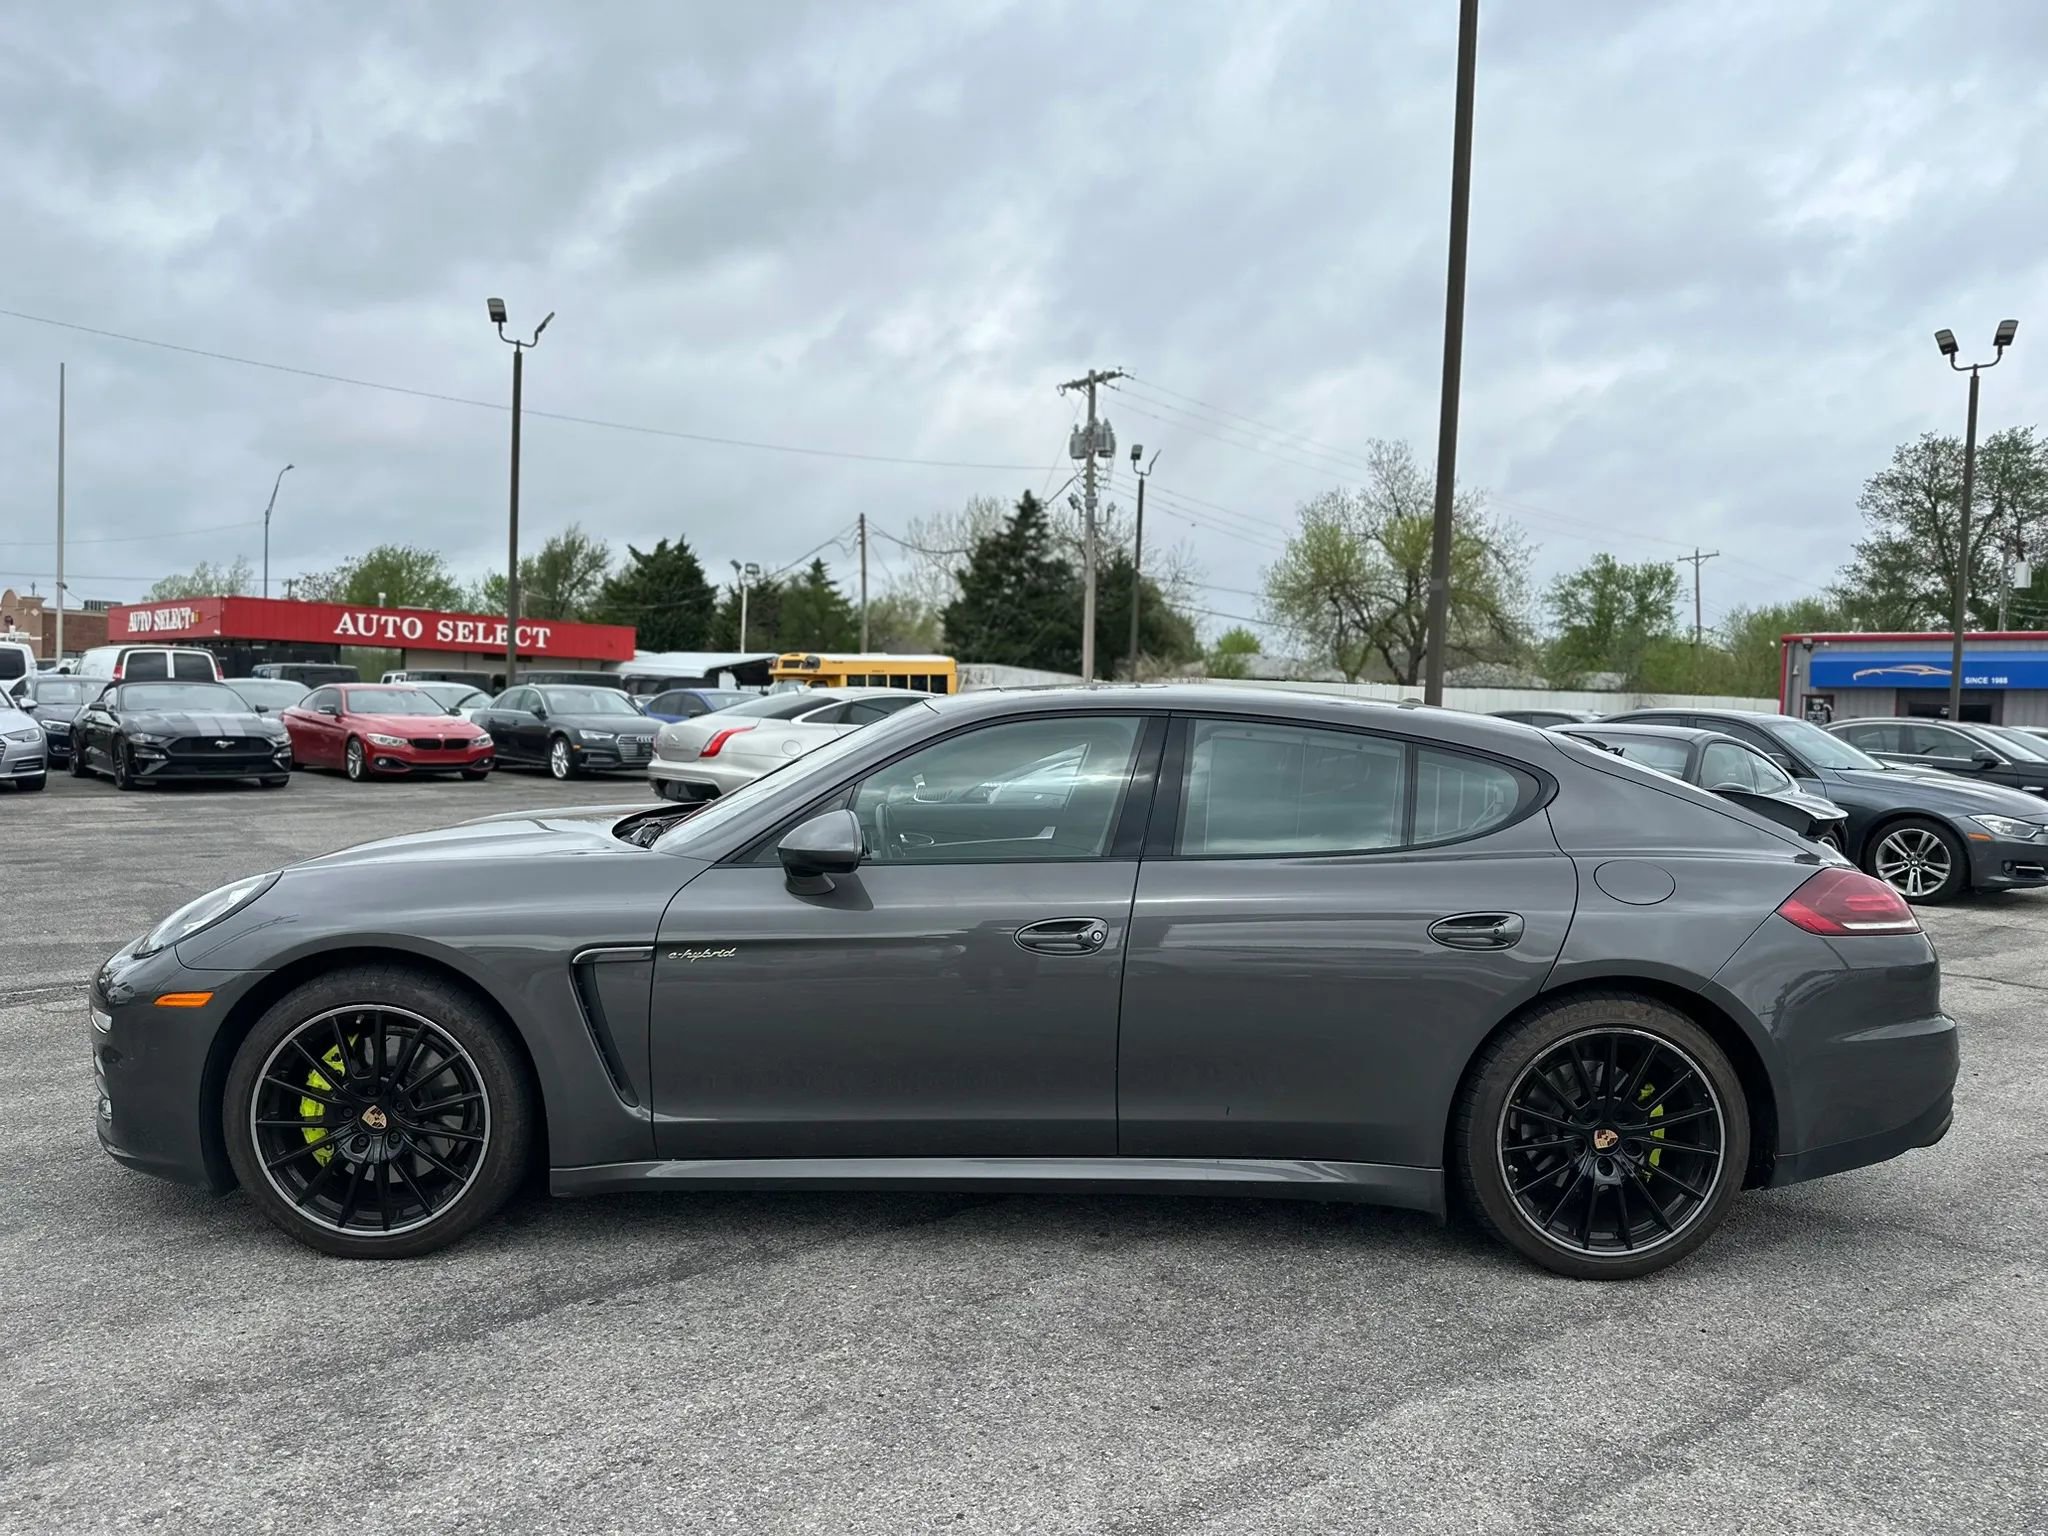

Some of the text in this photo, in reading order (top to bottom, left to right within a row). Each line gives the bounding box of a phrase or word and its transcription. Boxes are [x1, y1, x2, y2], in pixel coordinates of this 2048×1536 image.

[128, 607, 191, 632] AUTO SELECT
[334, 612, 551, 648] AUTO SELECT
[1964, 676, 1989, 685] SINCE
[668, 947, 737, 963] e-hybrid
